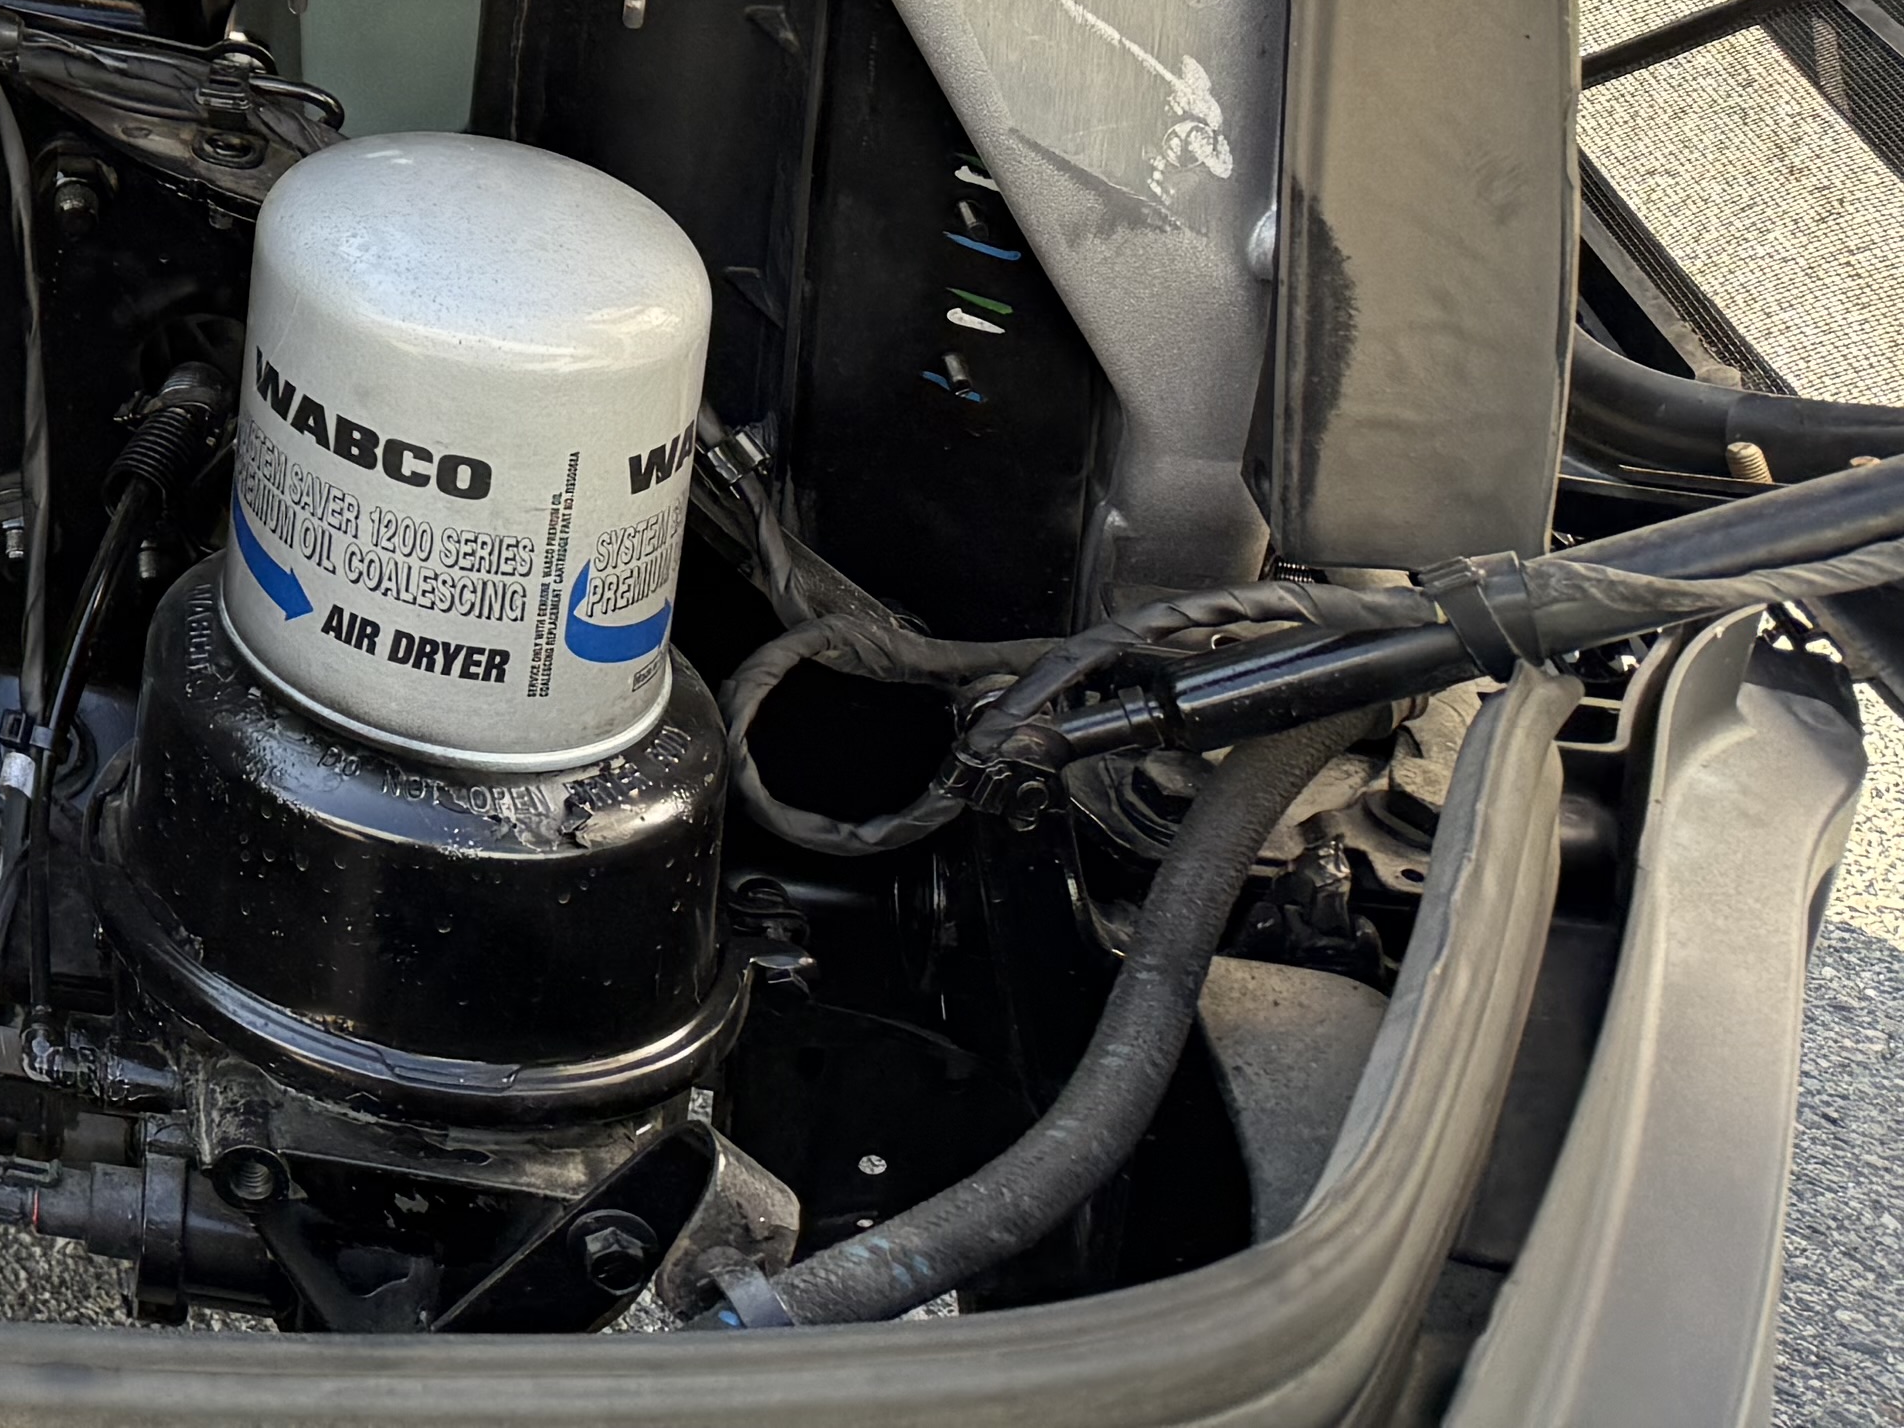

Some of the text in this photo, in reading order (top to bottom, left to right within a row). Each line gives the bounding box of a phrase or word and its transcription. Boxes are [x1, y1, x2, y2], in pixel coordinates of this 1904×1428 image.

[256, 345, 493, 501] WABCO
[290, 462, 361, 539] SAVER
[369, 505, 434, 562] 1200
[440, 526, 536, 578] SERIES
[542, 548, 555, 579] WABCO
[299, 517, 338, 576] OIL
[343, 542, 527, 623] COALESCING
[320, 603, 512, 684] AIR DRYER
[381, 769, 445, 805] NOT
[468, 784, 558, 816] OPEN
